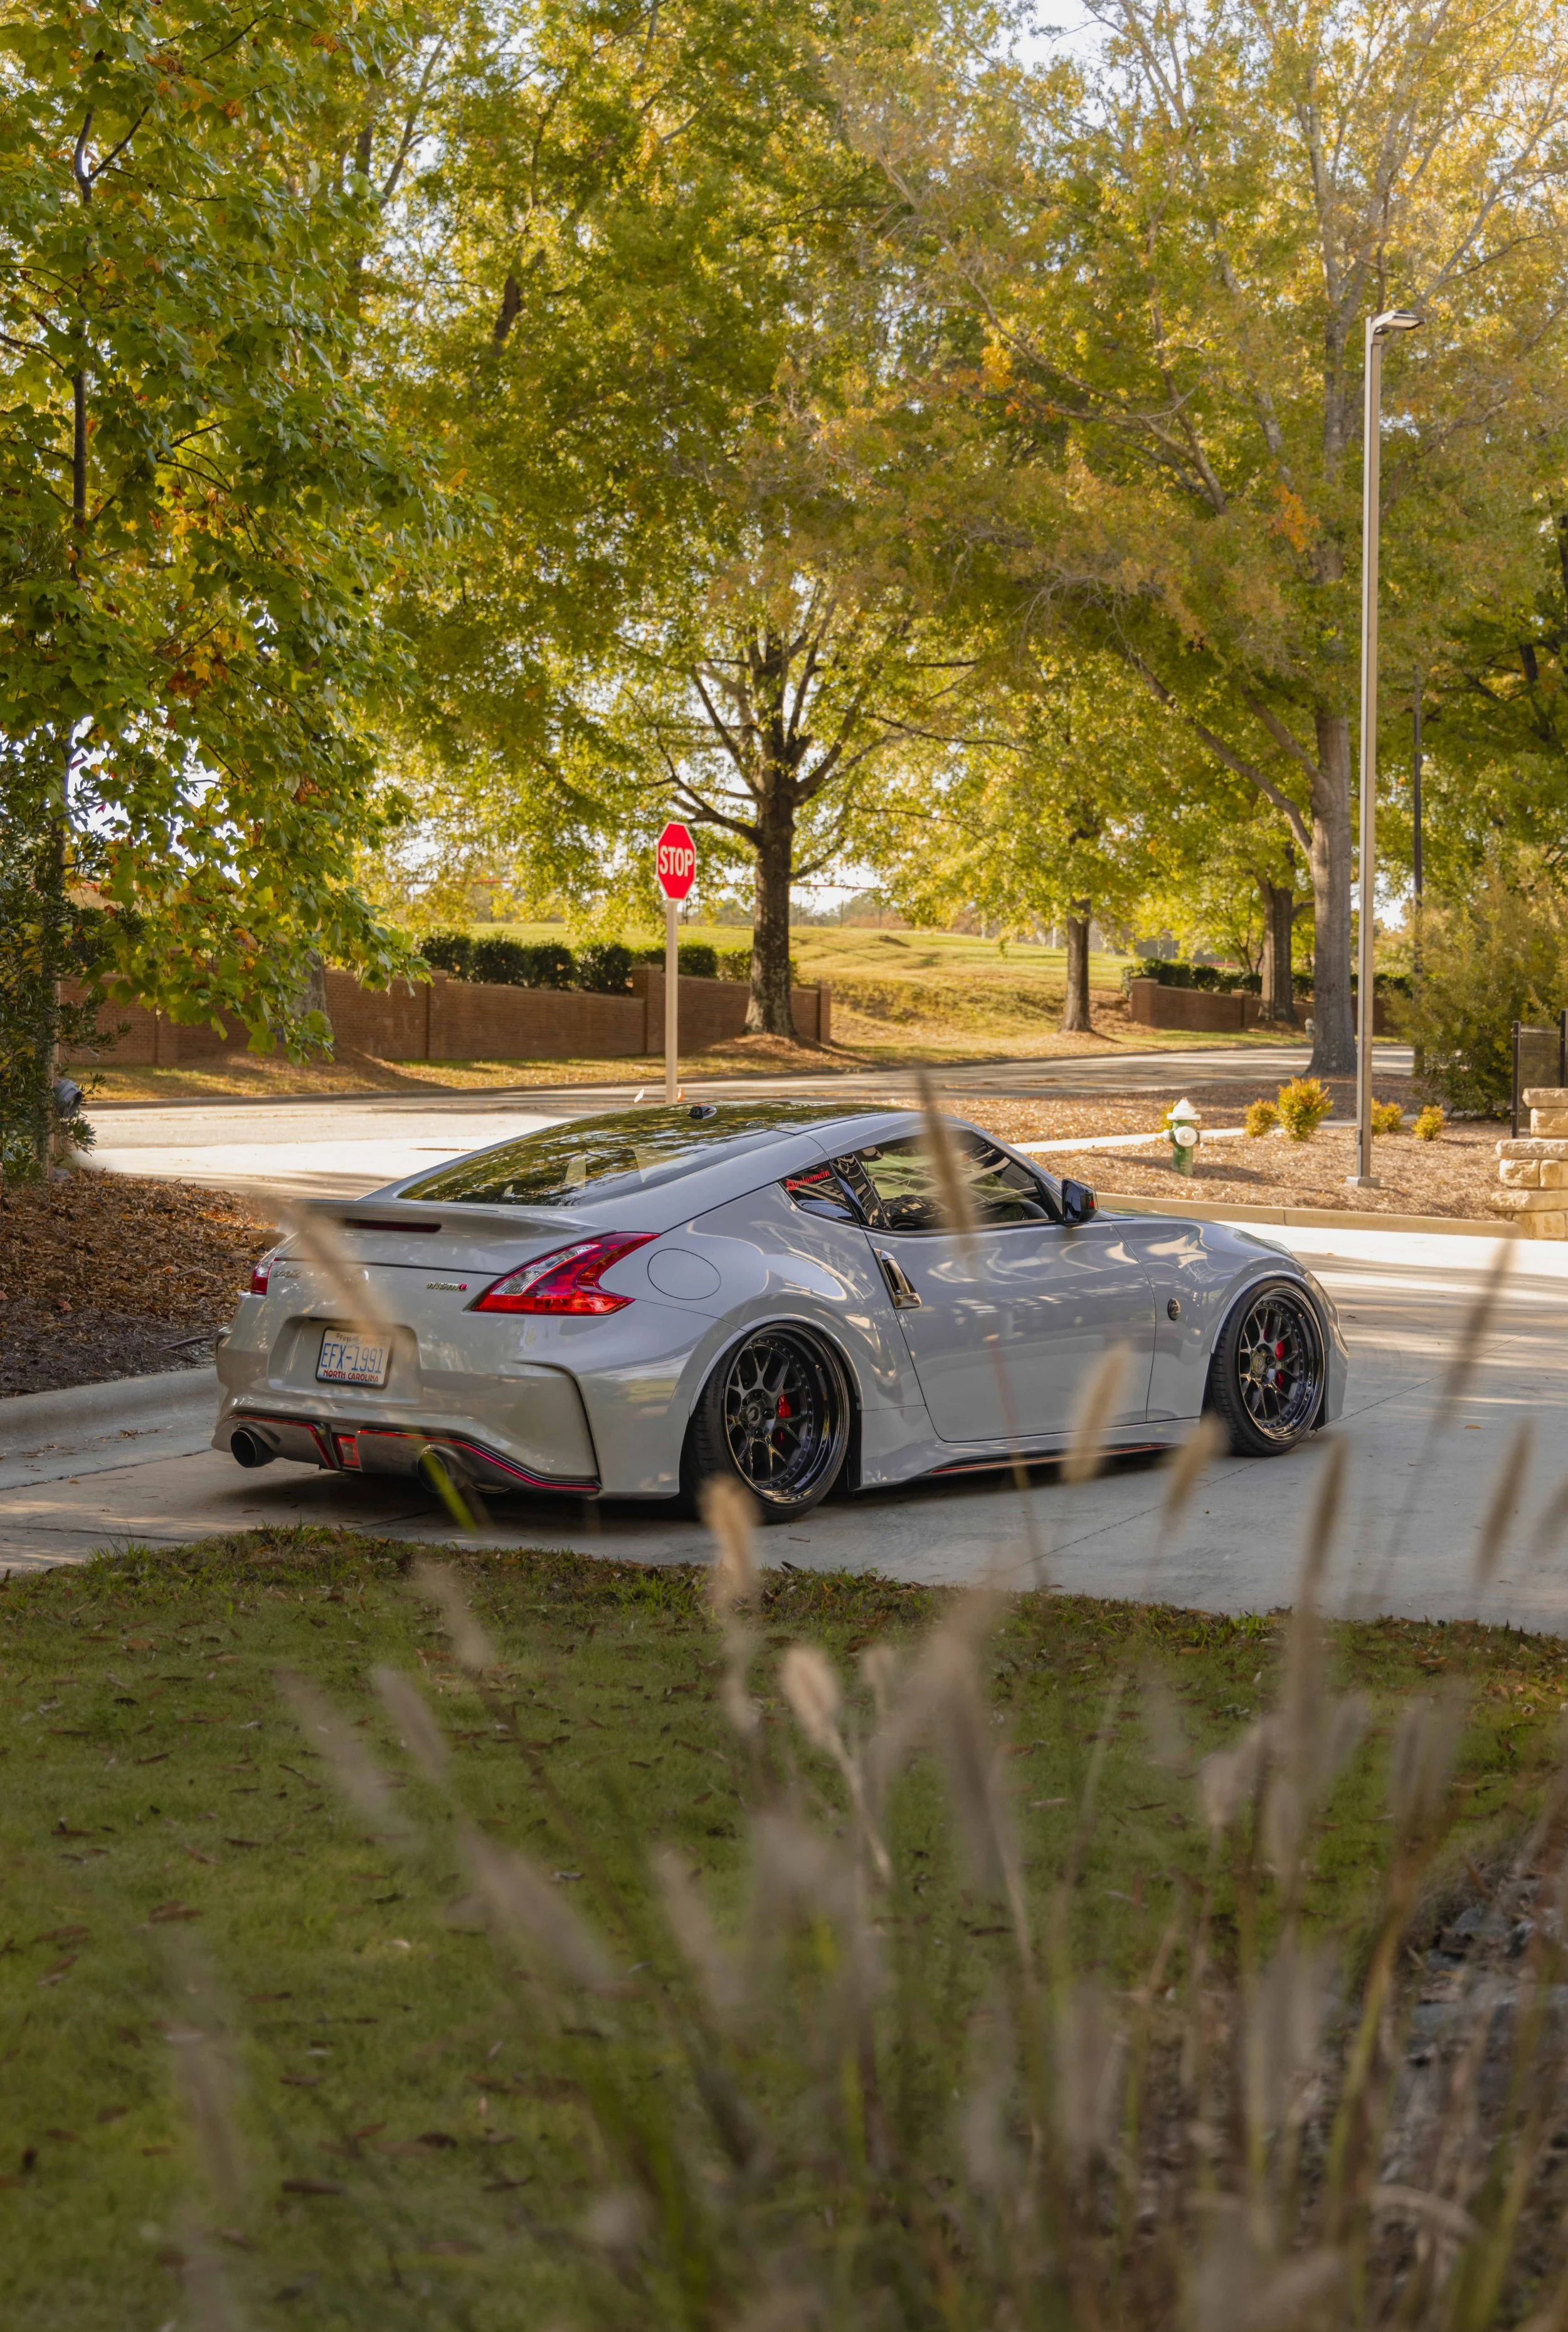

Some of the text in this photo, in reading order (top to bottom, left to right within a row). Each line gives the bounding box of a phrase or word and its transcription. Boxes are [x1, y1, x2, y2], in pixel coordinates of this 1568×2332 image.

[659, 844, 694, 877] STOP
[320, 1343, 383, 1373] EFX-1991
[323, 1370, 379, 1383] NORTH CAROLINA
